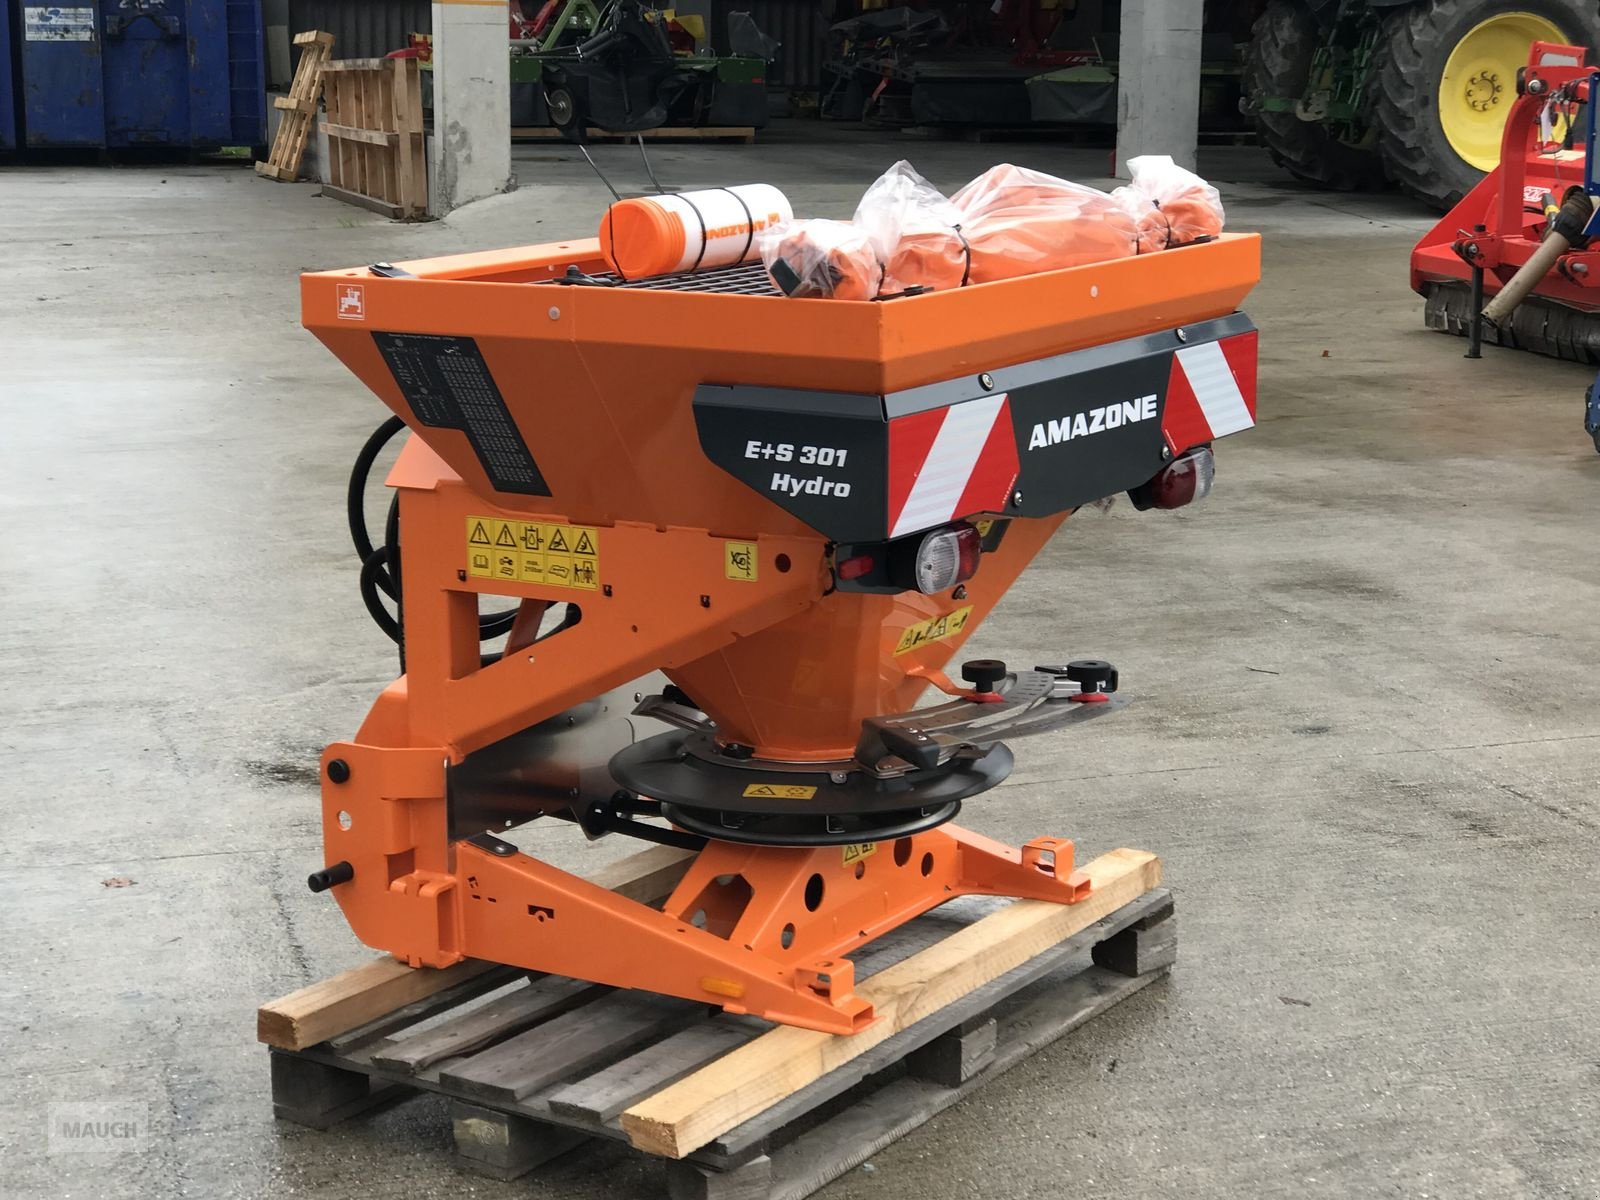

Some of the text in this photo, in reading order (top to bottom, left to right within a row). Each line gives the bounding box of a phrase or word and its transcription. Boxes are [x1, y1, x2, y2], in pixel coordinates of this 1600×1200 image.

[1028, 394, 1157, 451] AMAZONE
[744, 440, 848, 467] E+S 301
[770, 472, 851, 497] Hydro
